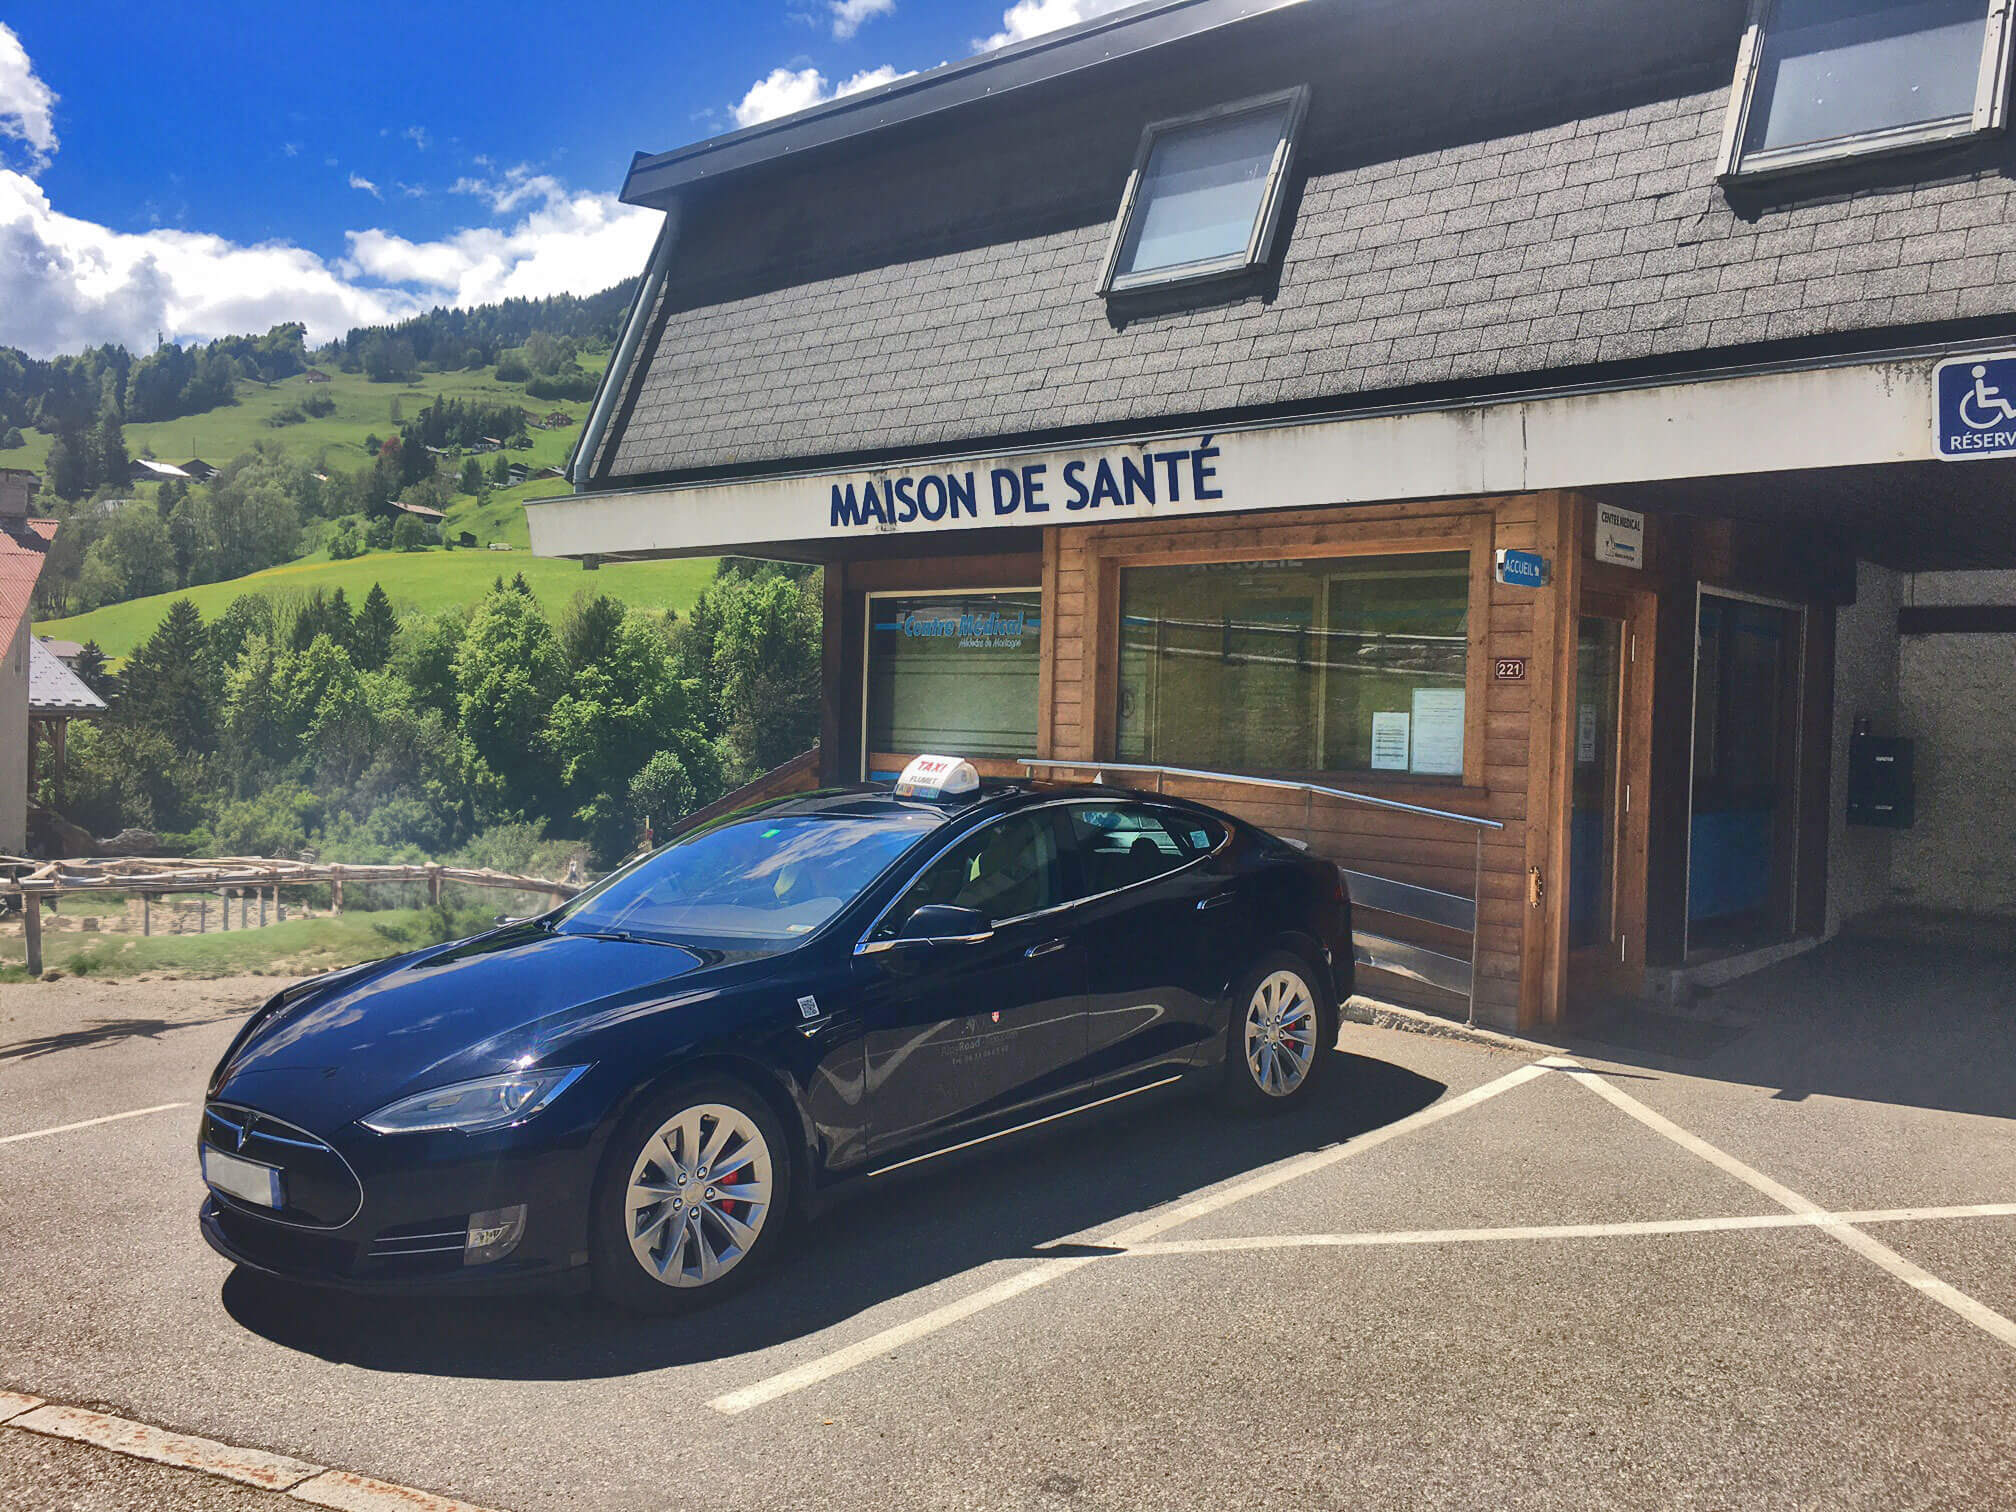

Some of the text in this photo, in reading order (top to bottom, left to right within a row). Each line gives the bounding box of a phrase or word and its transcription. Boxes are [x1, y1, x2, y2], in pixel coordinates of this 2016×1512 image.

[830, 434, 1223, 527] MAISON DE SANTÉ
[1601, 511, 1620, 527] CENTRE
[1505, 560, 1534, 577] ACCUEIL
[904, 611, 1024, 637] Centre Médical
[1498, 663, 1520, 675] 221
[917, 761, 948, 773] TAXI
